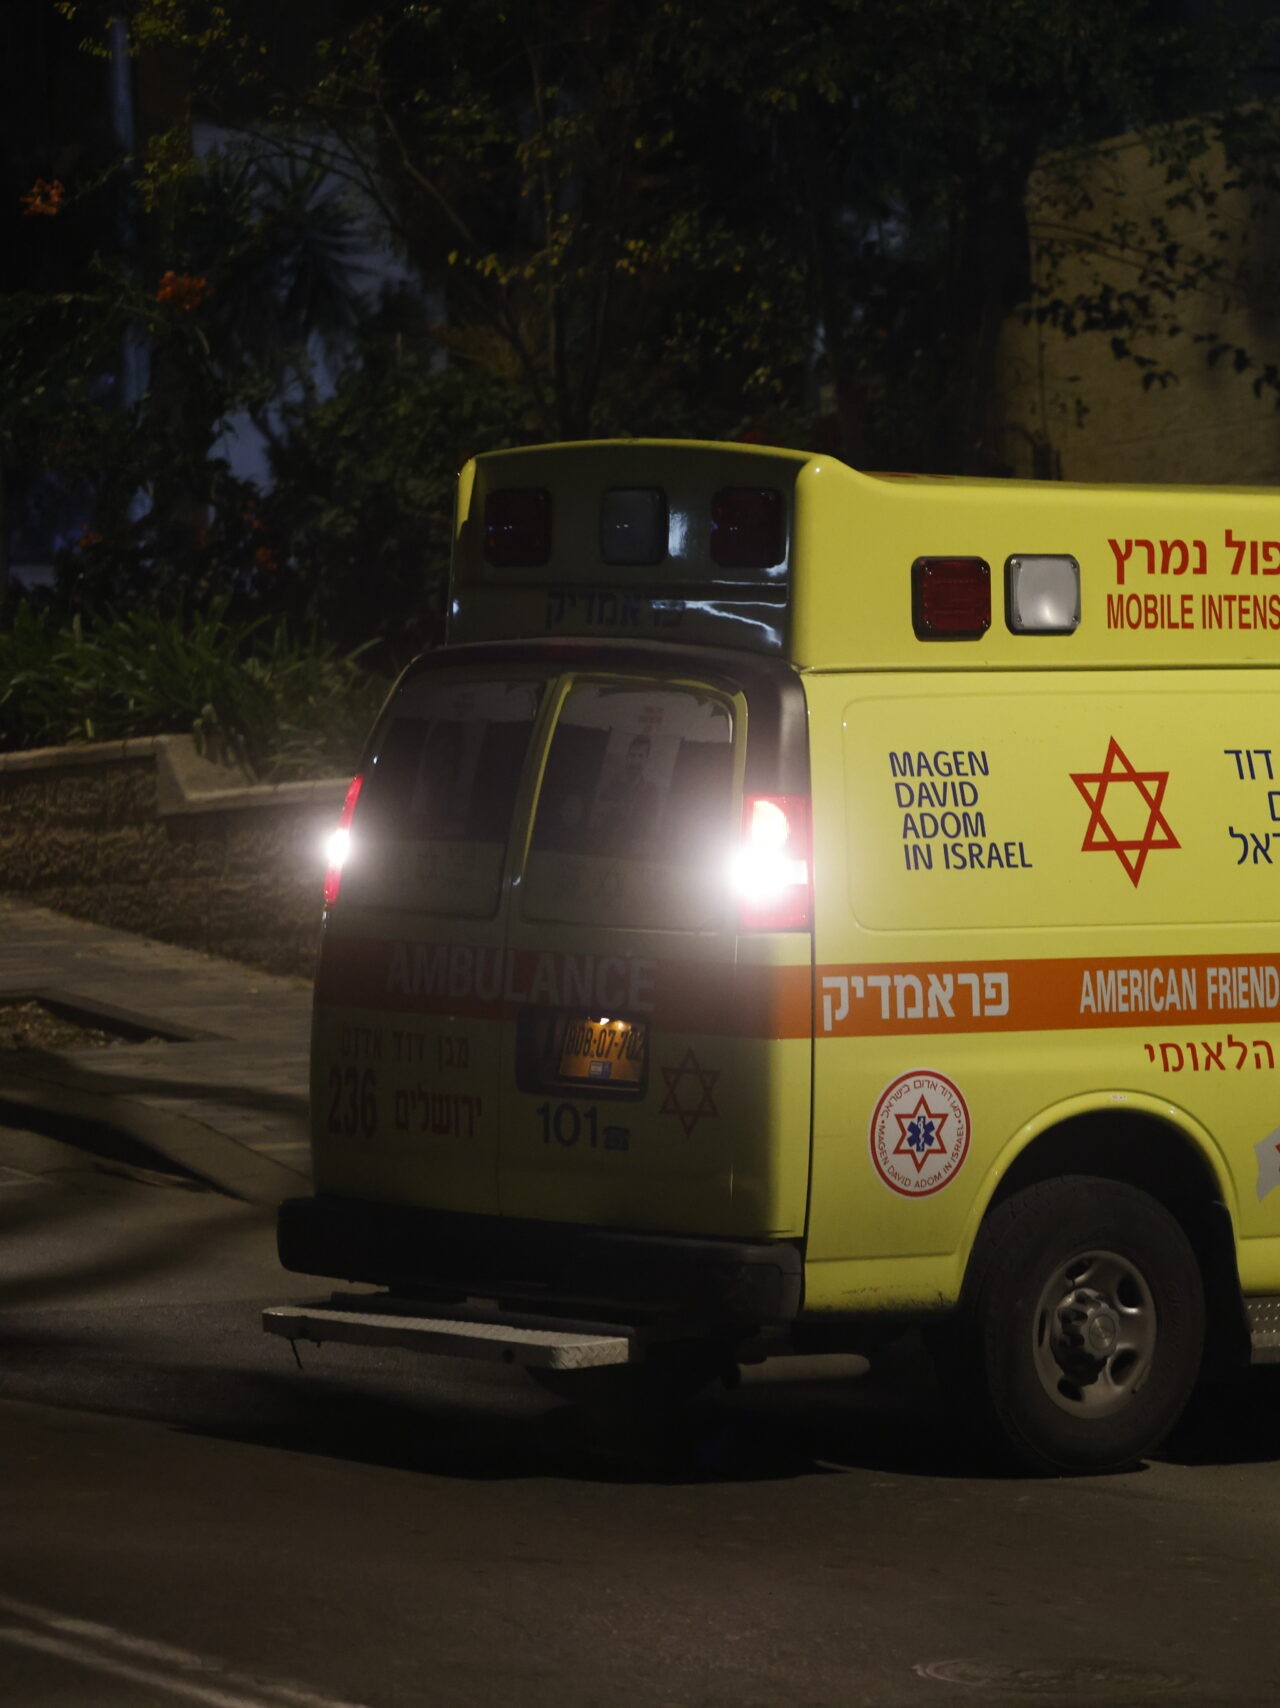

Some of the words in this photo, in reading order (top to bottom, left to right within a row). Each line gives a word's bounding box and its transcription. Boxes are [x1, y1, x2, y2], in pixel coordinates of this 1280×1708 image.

[1107, 538, 1208, 585] נמרץ
[1106, 593, 1195, 630] MOBILE
[888, 751, 990, 778] MAGEN
[1223, 749, 1275, 782] דוד
[893, 781, 979, 809] DAVID
[902, 811, 987, 840] ADOM
[903, 844, 934, 871] IN
[942, 841, 1034, 871] ISRAEL
[385, 941, 658, 1012] AMBULANCE
[1079, 966, 1197, 1014] AMERICAN
[821, 971, 1010, 1032] פראמדיק
[1144, 1034, 1275, 1073] הלאומי
[328, 1064, 378, 1139] 236
[880, 1084, 911, 1118] בישראל
[913, 1079, 938, 1090] אדום
[393, 1082, 483, 1138] ירושלים
[536, 1102, 599, 1148] 101
[878, 1125, 890, 1165] MAGEN
[887, 1165, 912, 1187] DAVID
[914, 1173, 942, 1188] ADOM
[943, 1163, 952, 1174] IN
[951, 1125, 963, 1162] ISRAEL
